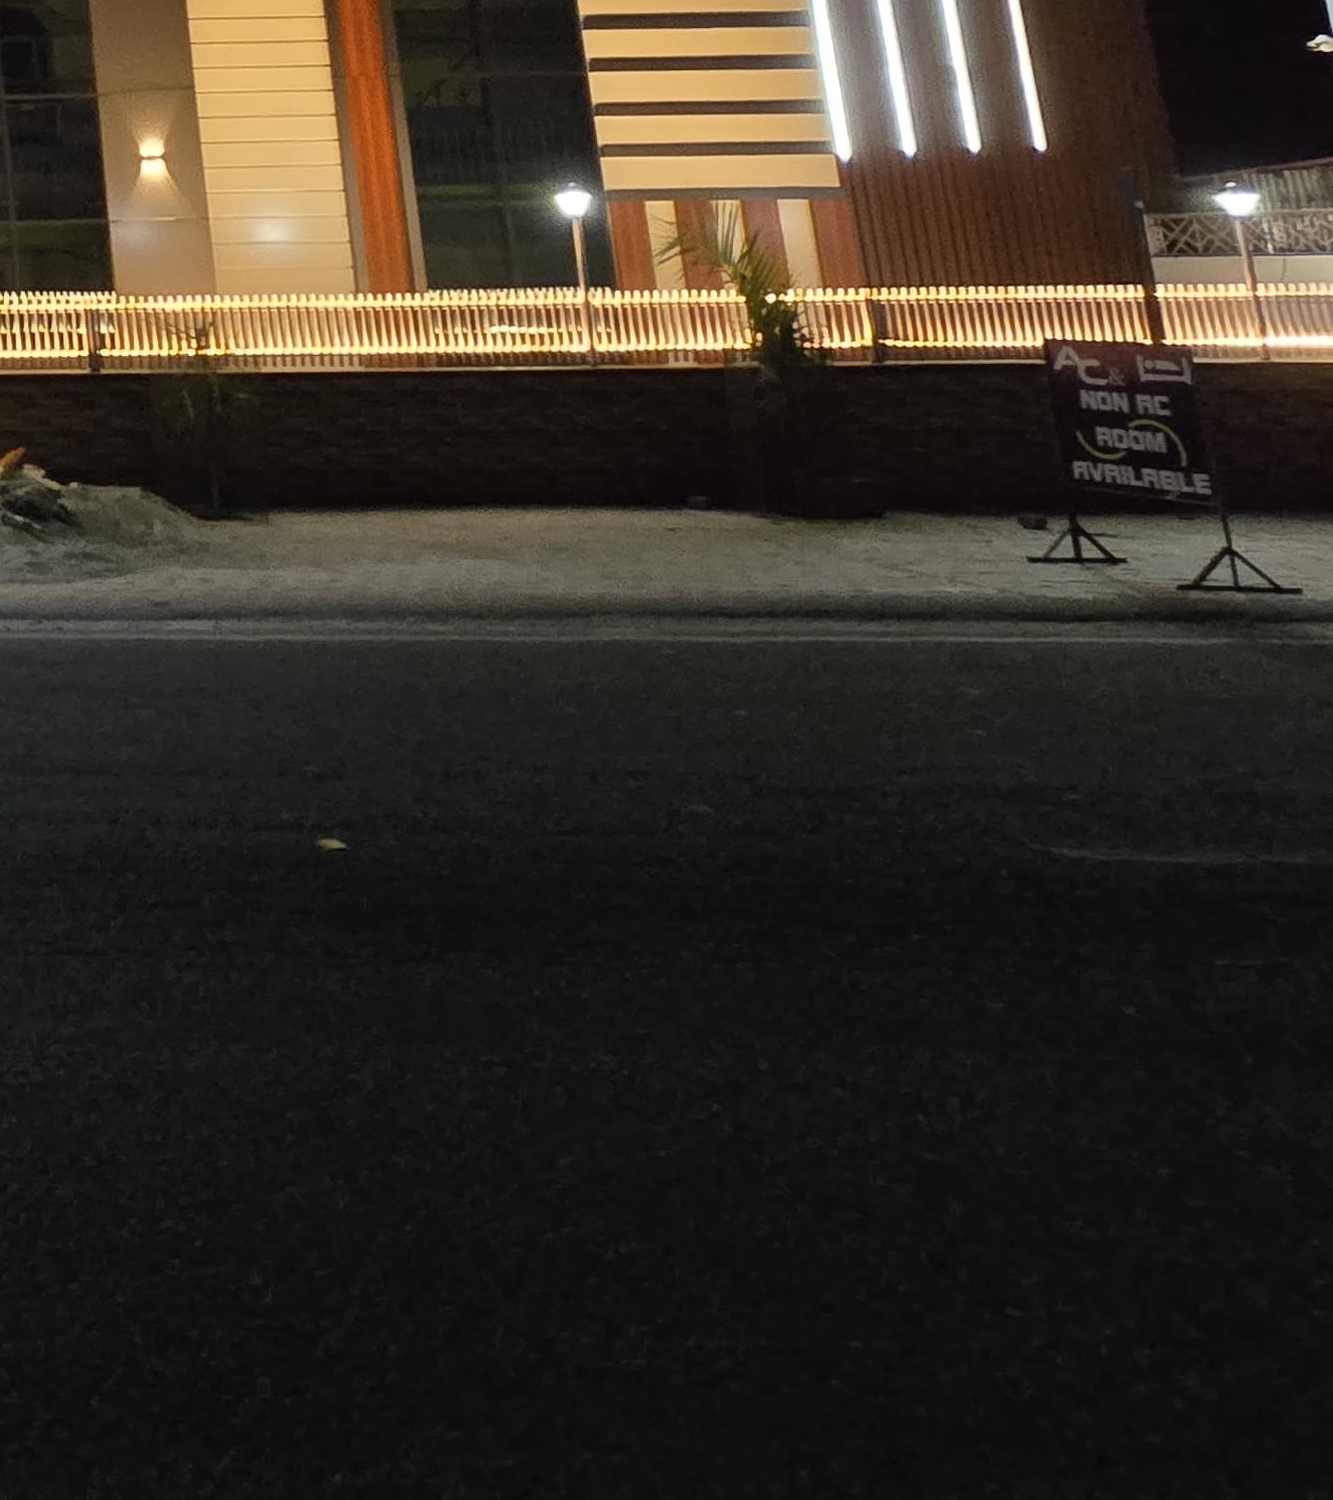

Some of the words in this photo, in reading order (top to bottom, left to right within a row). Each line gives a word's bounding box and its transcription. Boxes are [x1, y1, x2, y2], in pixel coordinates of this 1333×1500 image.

[1079, 388, 1129, 414] NON
[1094, 426, 1168, 453] ROOM
[1071, 460, 1213, 496] AVAILABLE
